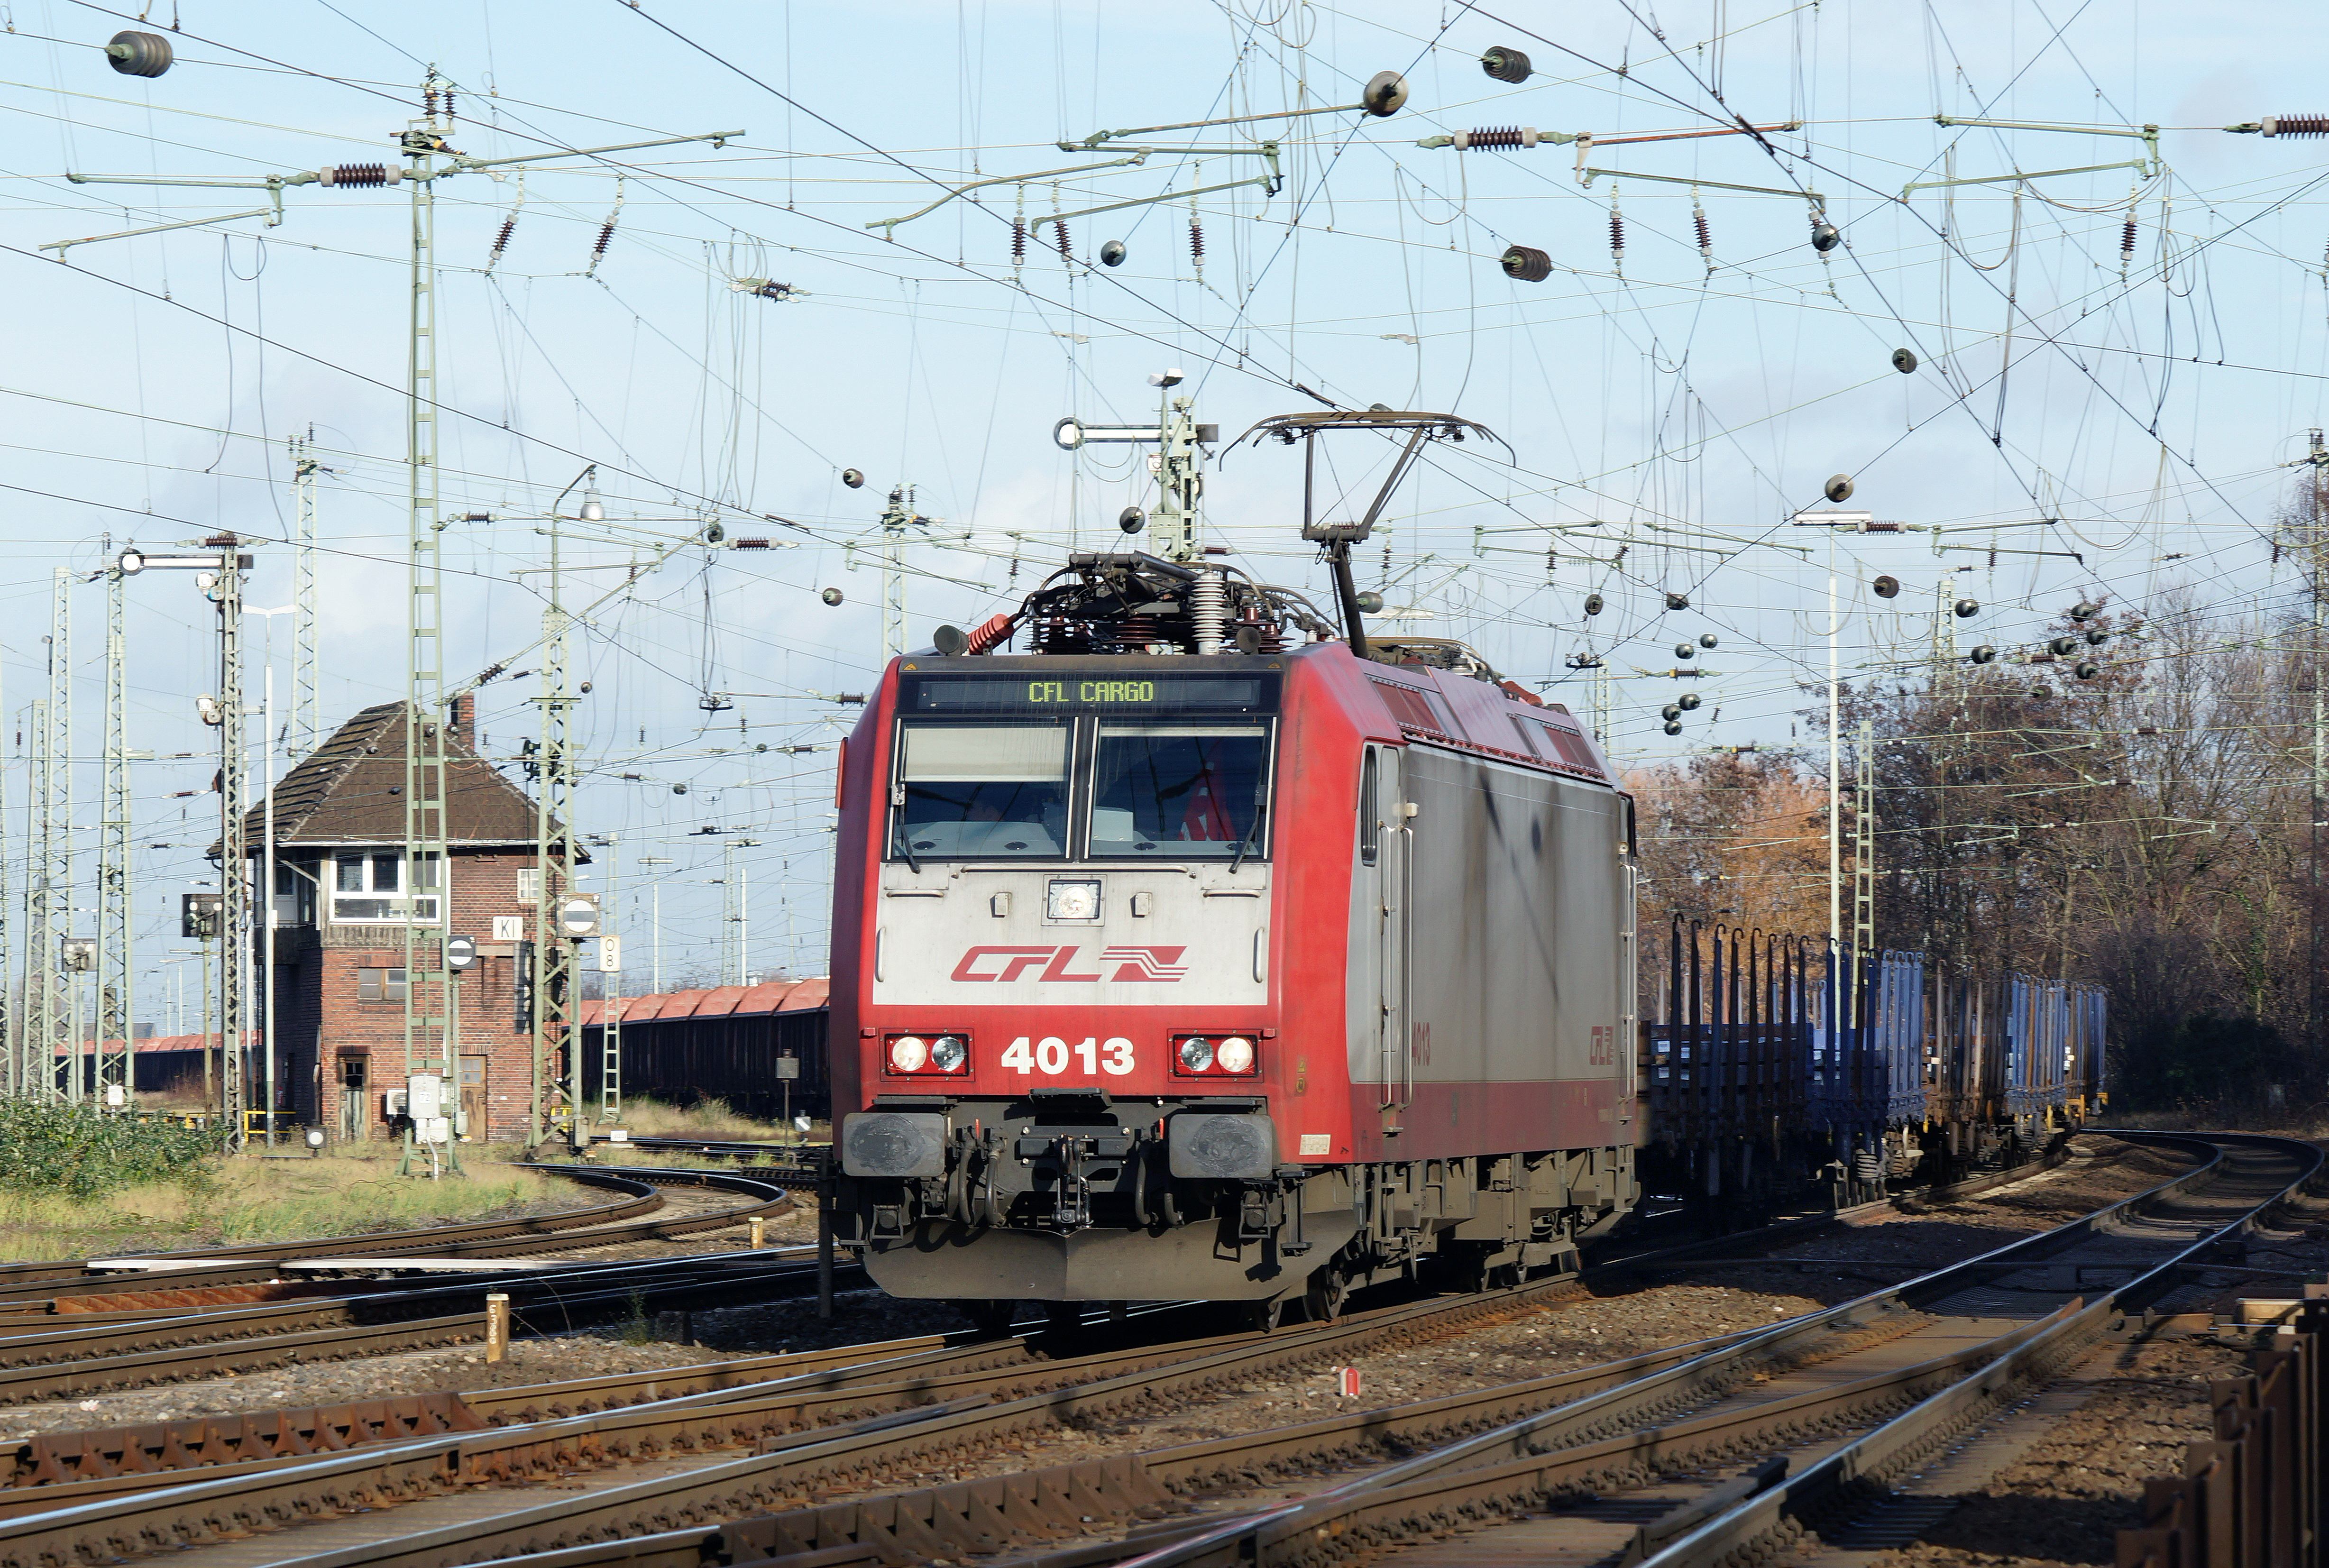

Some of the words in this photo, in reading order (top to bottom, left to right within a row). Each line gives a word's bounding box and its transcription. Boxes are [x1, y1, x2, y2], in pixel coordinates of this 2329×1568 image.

[1029, 682, 1069, 702] CFL
[1081, 682, 1153, 702] CARGO
[607, 954, 613, 966] 8
[950, 946, 1103, 982] CFL
[1001, 1036, 1135, 1075] 4013
